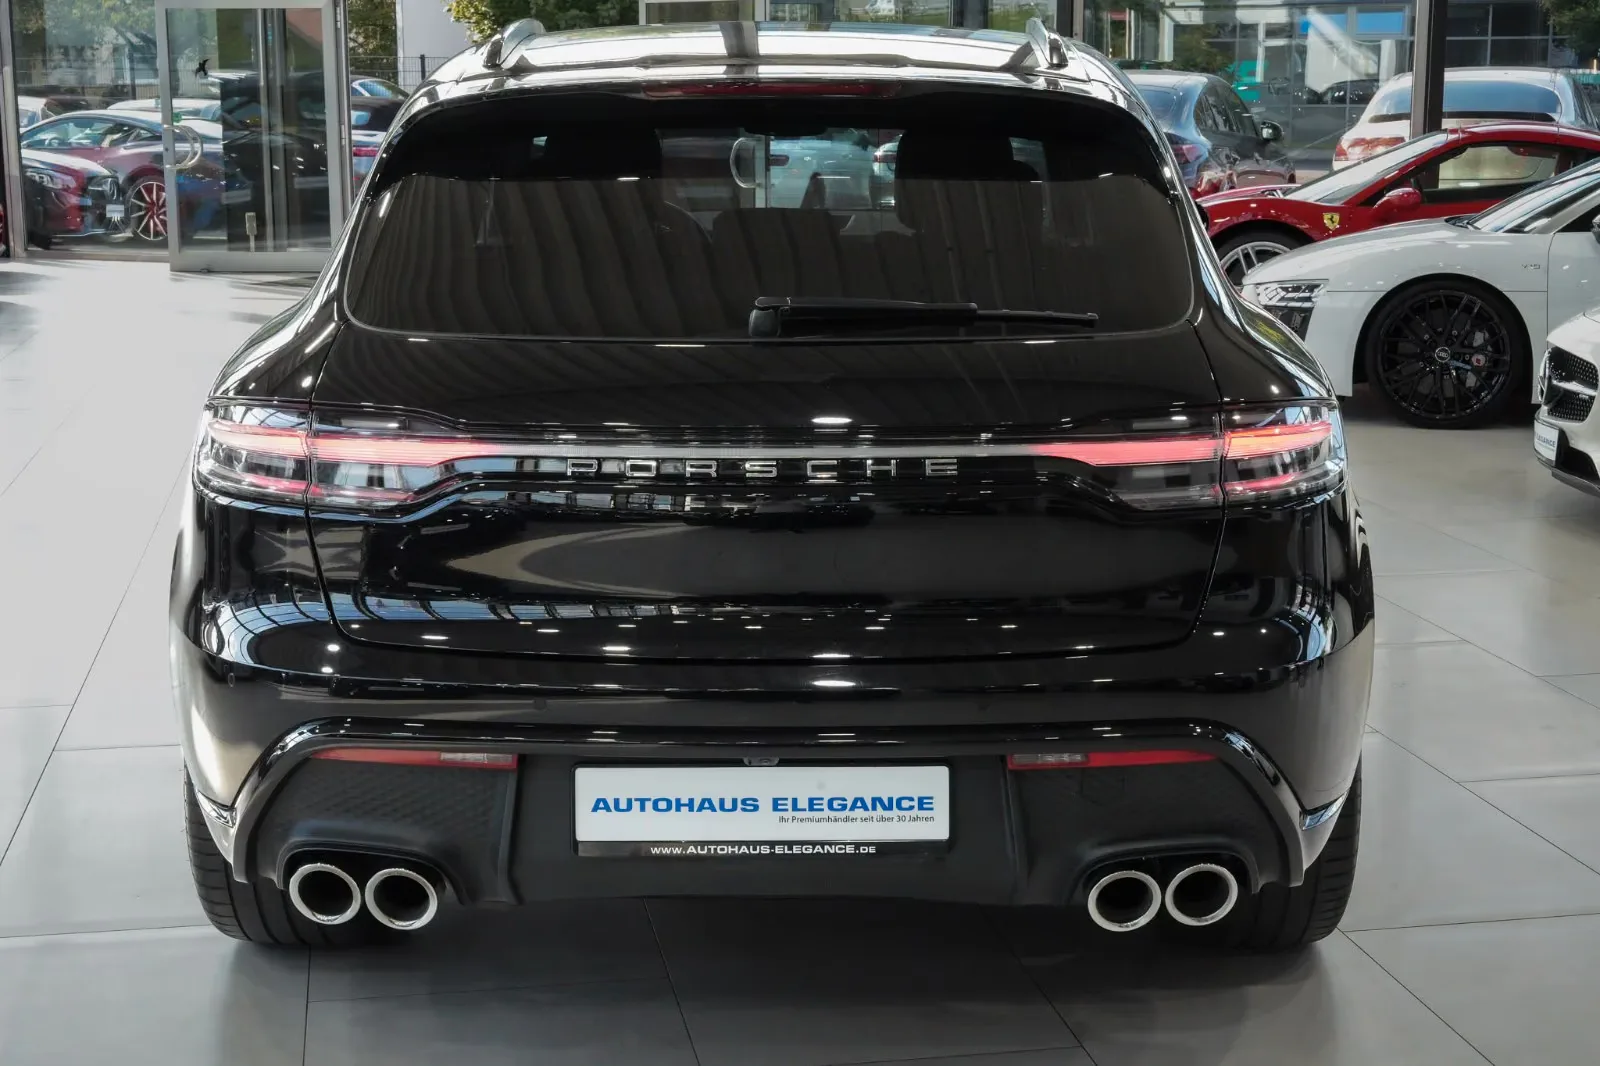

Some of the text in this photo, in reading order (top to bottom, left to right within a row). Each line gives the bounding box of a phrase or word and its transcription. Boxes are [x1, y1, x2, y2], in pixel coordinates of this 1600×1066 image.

[567, 458, 958, 478] PORSCHE
[591, 796, 935, 813] AUTOHAUS ELEGANCE
[779, 814, 935, 824] Ihr Premiumhändler seit über 30 Jahren
[650, 844, 877, 855] www.AUTOHAUS-ELEGANCE.DE
